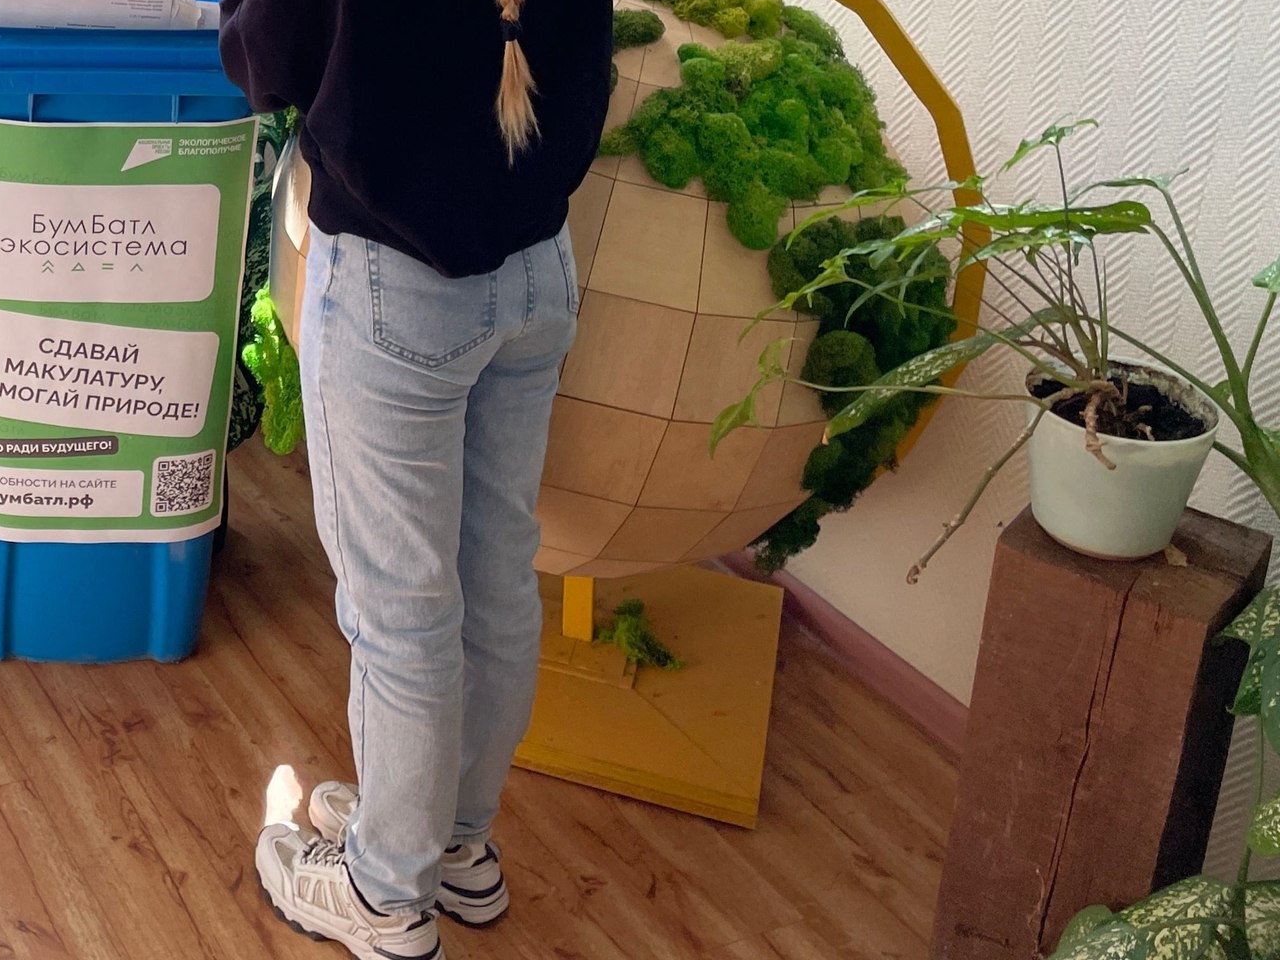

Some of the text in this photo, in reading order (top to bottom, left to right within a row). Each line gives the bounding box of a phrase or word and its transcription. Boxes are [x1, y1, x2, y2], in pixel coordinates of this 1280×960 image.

[178, 133, 247, 148] ЭКОЛОГИЧЕСКОЕ
[178, 142, 243, 156] БЛАГОПОЛУЧИЕ
[32, 213, 156, 239] БумБатл
[38, 337, 140, 365] СДАВАЙ
[4, 357, 166, 395] МАКУЛАТУРУ,
[85, 394, 200, 421] ПРИРОДЕ!
[6, 442, 39, 455] РАДИ
[41, 440, 113, 454] БУДУЩЕГО!
[59, 479, 76, 489] НА
[78, 478, 118, 489] САЙТЕ
